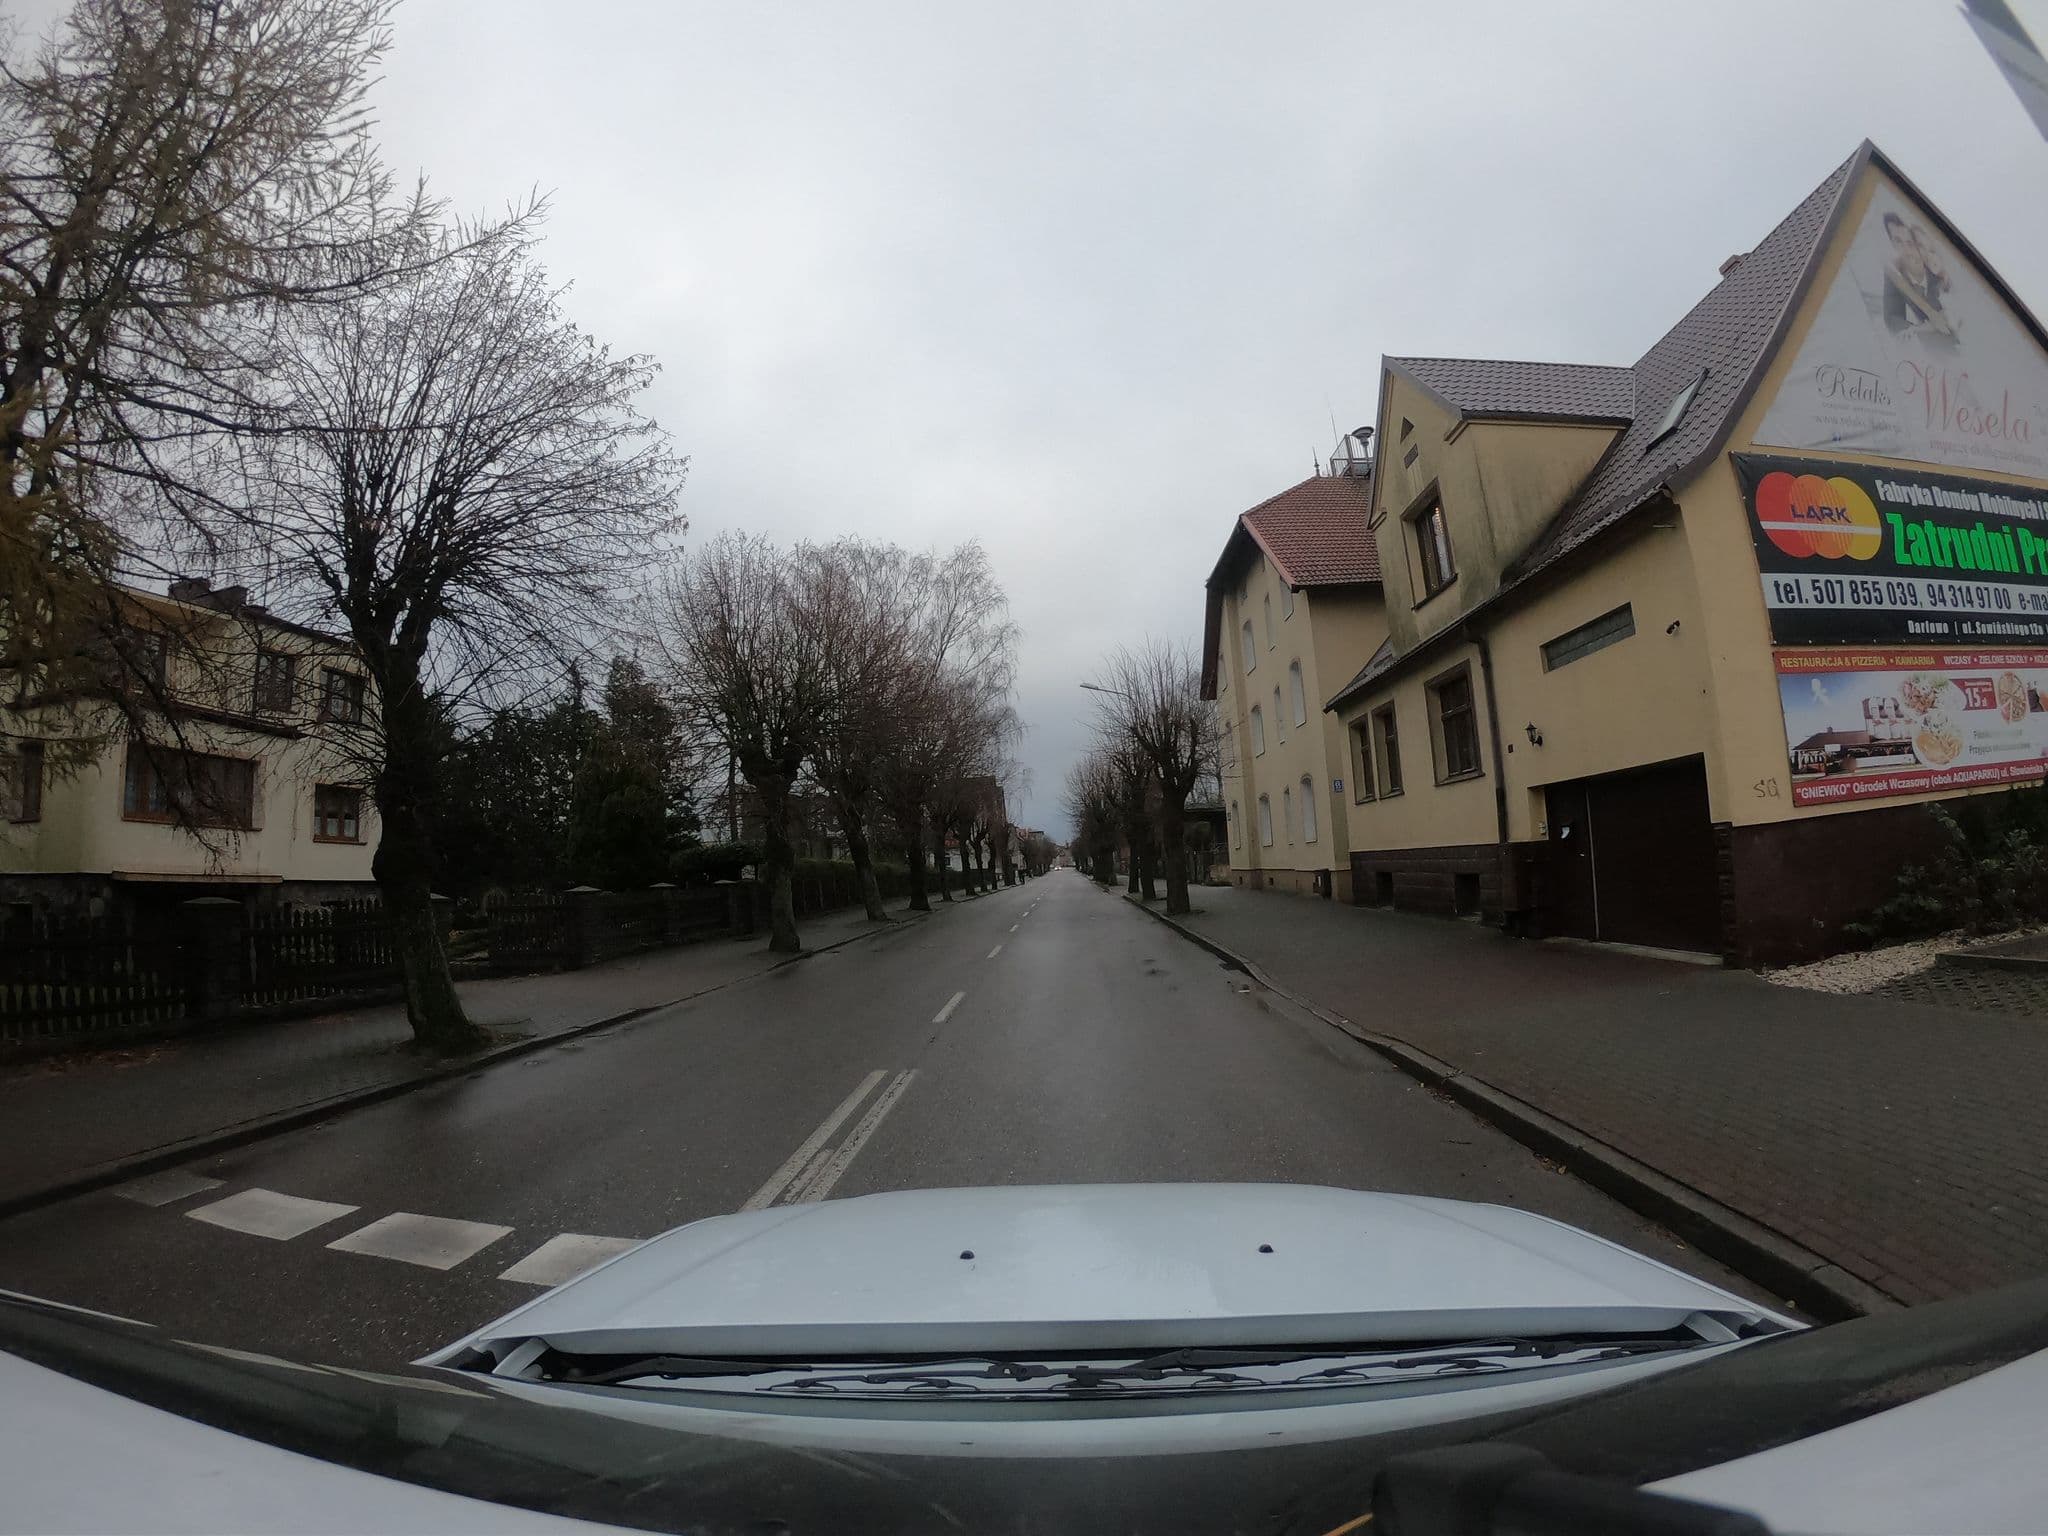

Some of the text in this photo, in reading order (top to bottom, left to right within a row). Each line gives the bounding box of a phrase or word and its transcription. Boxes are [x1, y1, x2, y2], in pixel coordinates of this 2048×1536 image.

[1815, 364, 1893, 406] Relaks
[1896, 360, 2033, 441] Wesela
[1874, 479, 1934, 507] Fabryka
[1931, 486, 1980, 512] Domów
[1978, 492, 2039, 519] Mobilnych
[1790, 504, 1852, 523] LARK
[1885, 512, 2048, 577] Zatrudni Pr
[1773, 579, 1809, 605] tel.
[1812, 579, 1846, 605] 507
[1850, 580, 1884, 606] 855
[1886, 581, 1923, 608] 039,
[1926, 584, 1947, 608] 94
[1948, 584, 1974, 609] 314
[1975, 587, 1992, 609] 97
[1993, 587, 2012, 610] 00
[1962, 621, 1975, 634] ul.
[1779, 655, 1936, 669] RESTAURACJA & PIZZERIA KAWIARNIA
[1943, 655, 1972, 665] WCZASY
[1966, 687, 1982, 708] 15
[1852, 778, 1889, 794] Ośrodek
[1889, 776, 1930, 791] Wczasowy
[1952, 767, 2001, 783] AQUAPARKU)
